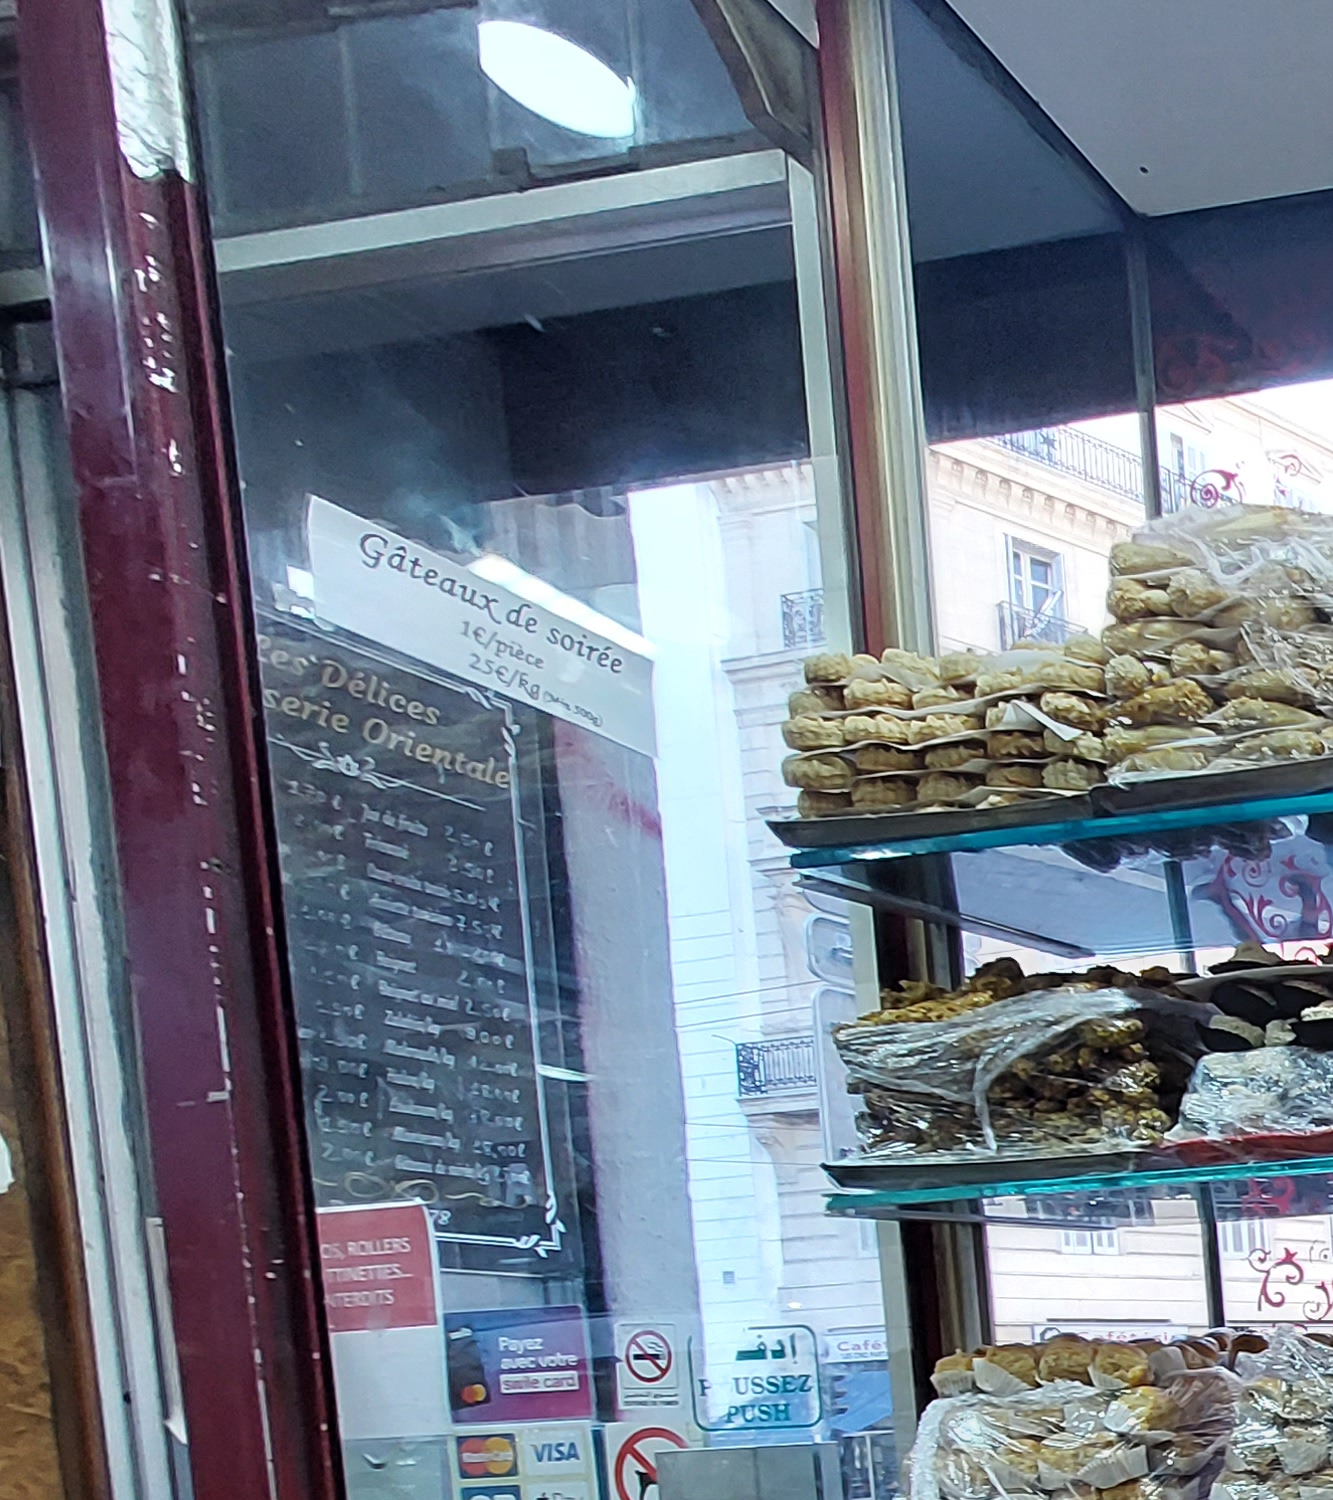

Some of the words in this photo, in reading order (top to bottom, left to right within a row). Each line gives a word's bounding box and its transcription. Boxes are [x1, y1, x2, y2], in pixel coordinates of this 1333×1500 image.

[359, 533, 502, 625] Gâteaux
[506, 603, 538, 634] de
[546, 625, 624, 674] soirée
[460, 621, 545, 670] 1€/pièce
[469, 652, 541, 701] 25€/kg
[321, 659, 441, 725] Délices
[263, 688, 350, 734] serie
[362, 717, 511, 789] Orientale
[321, 1243, 346, 1260] OS,
[346, 1237, 411, 1256] ROLLERS
[325, 1289, 394, 1308] NTERDITS
[498, 1336, 544, 1354] Payez
[837, 1339, 885, 1352] Café
[501, 1357, 536, 1370] avec
[538, 1352, 578, 1368] votre
[699, 1374, 814, 1398] PUSSEZ
[726, 1403, 791, 1424] PUSH
[533, 1442, 581, 1463] VISA
